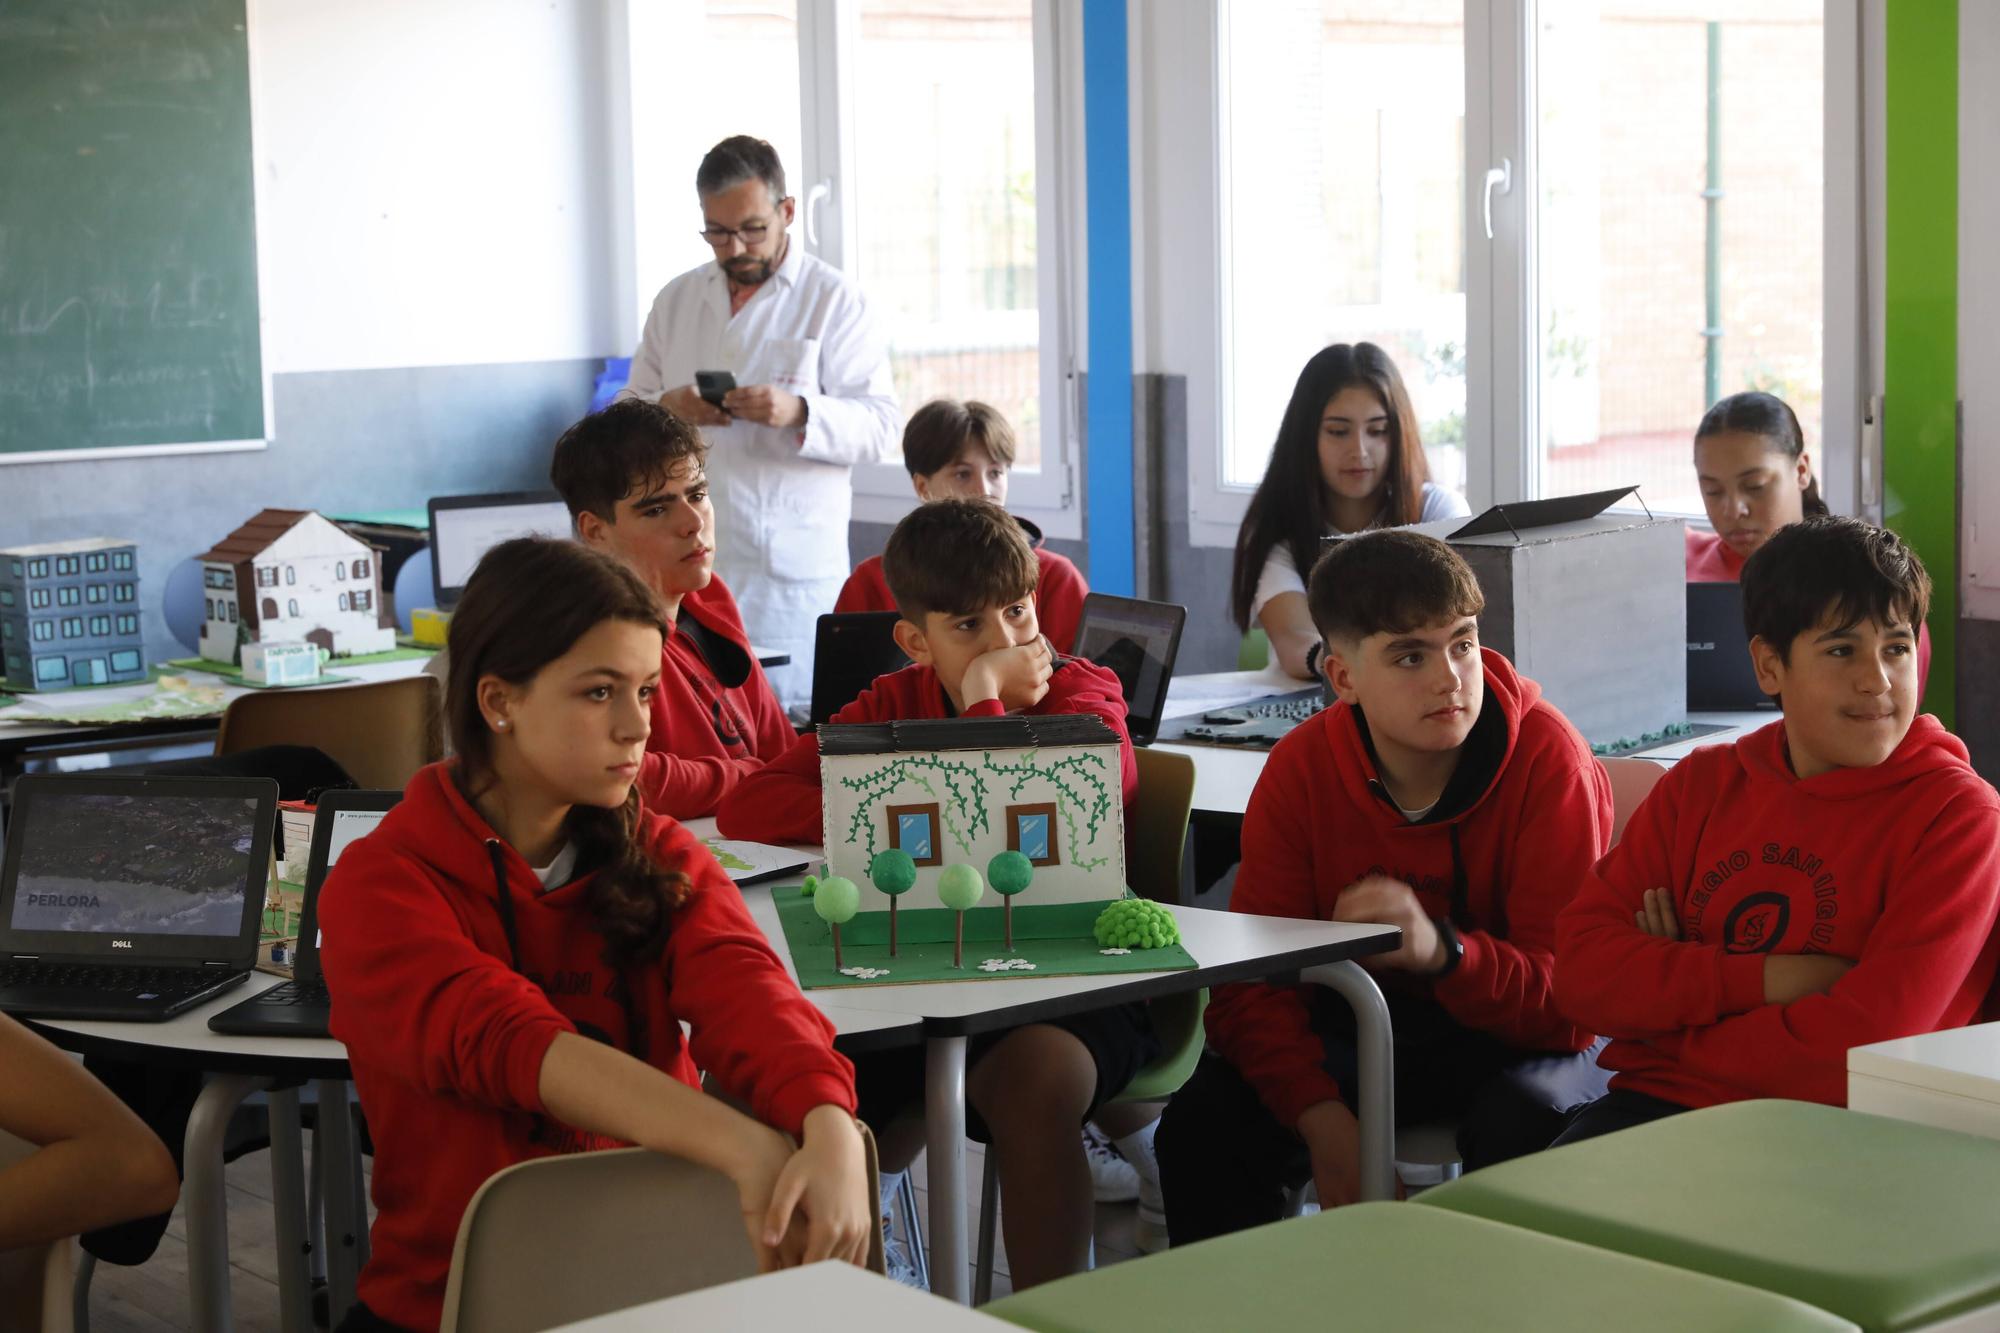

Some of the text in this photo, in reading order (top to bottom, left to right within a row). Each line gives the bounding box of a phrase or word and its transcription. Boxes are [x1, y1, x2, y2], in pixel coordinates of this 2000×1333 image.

[1687, 850, 1750, 942] OLEGIO
[1762, 843, 1824, 877] SAN
[28, 894, 100, 908] PERLORA
[112, 940, 132, 948] DELL
